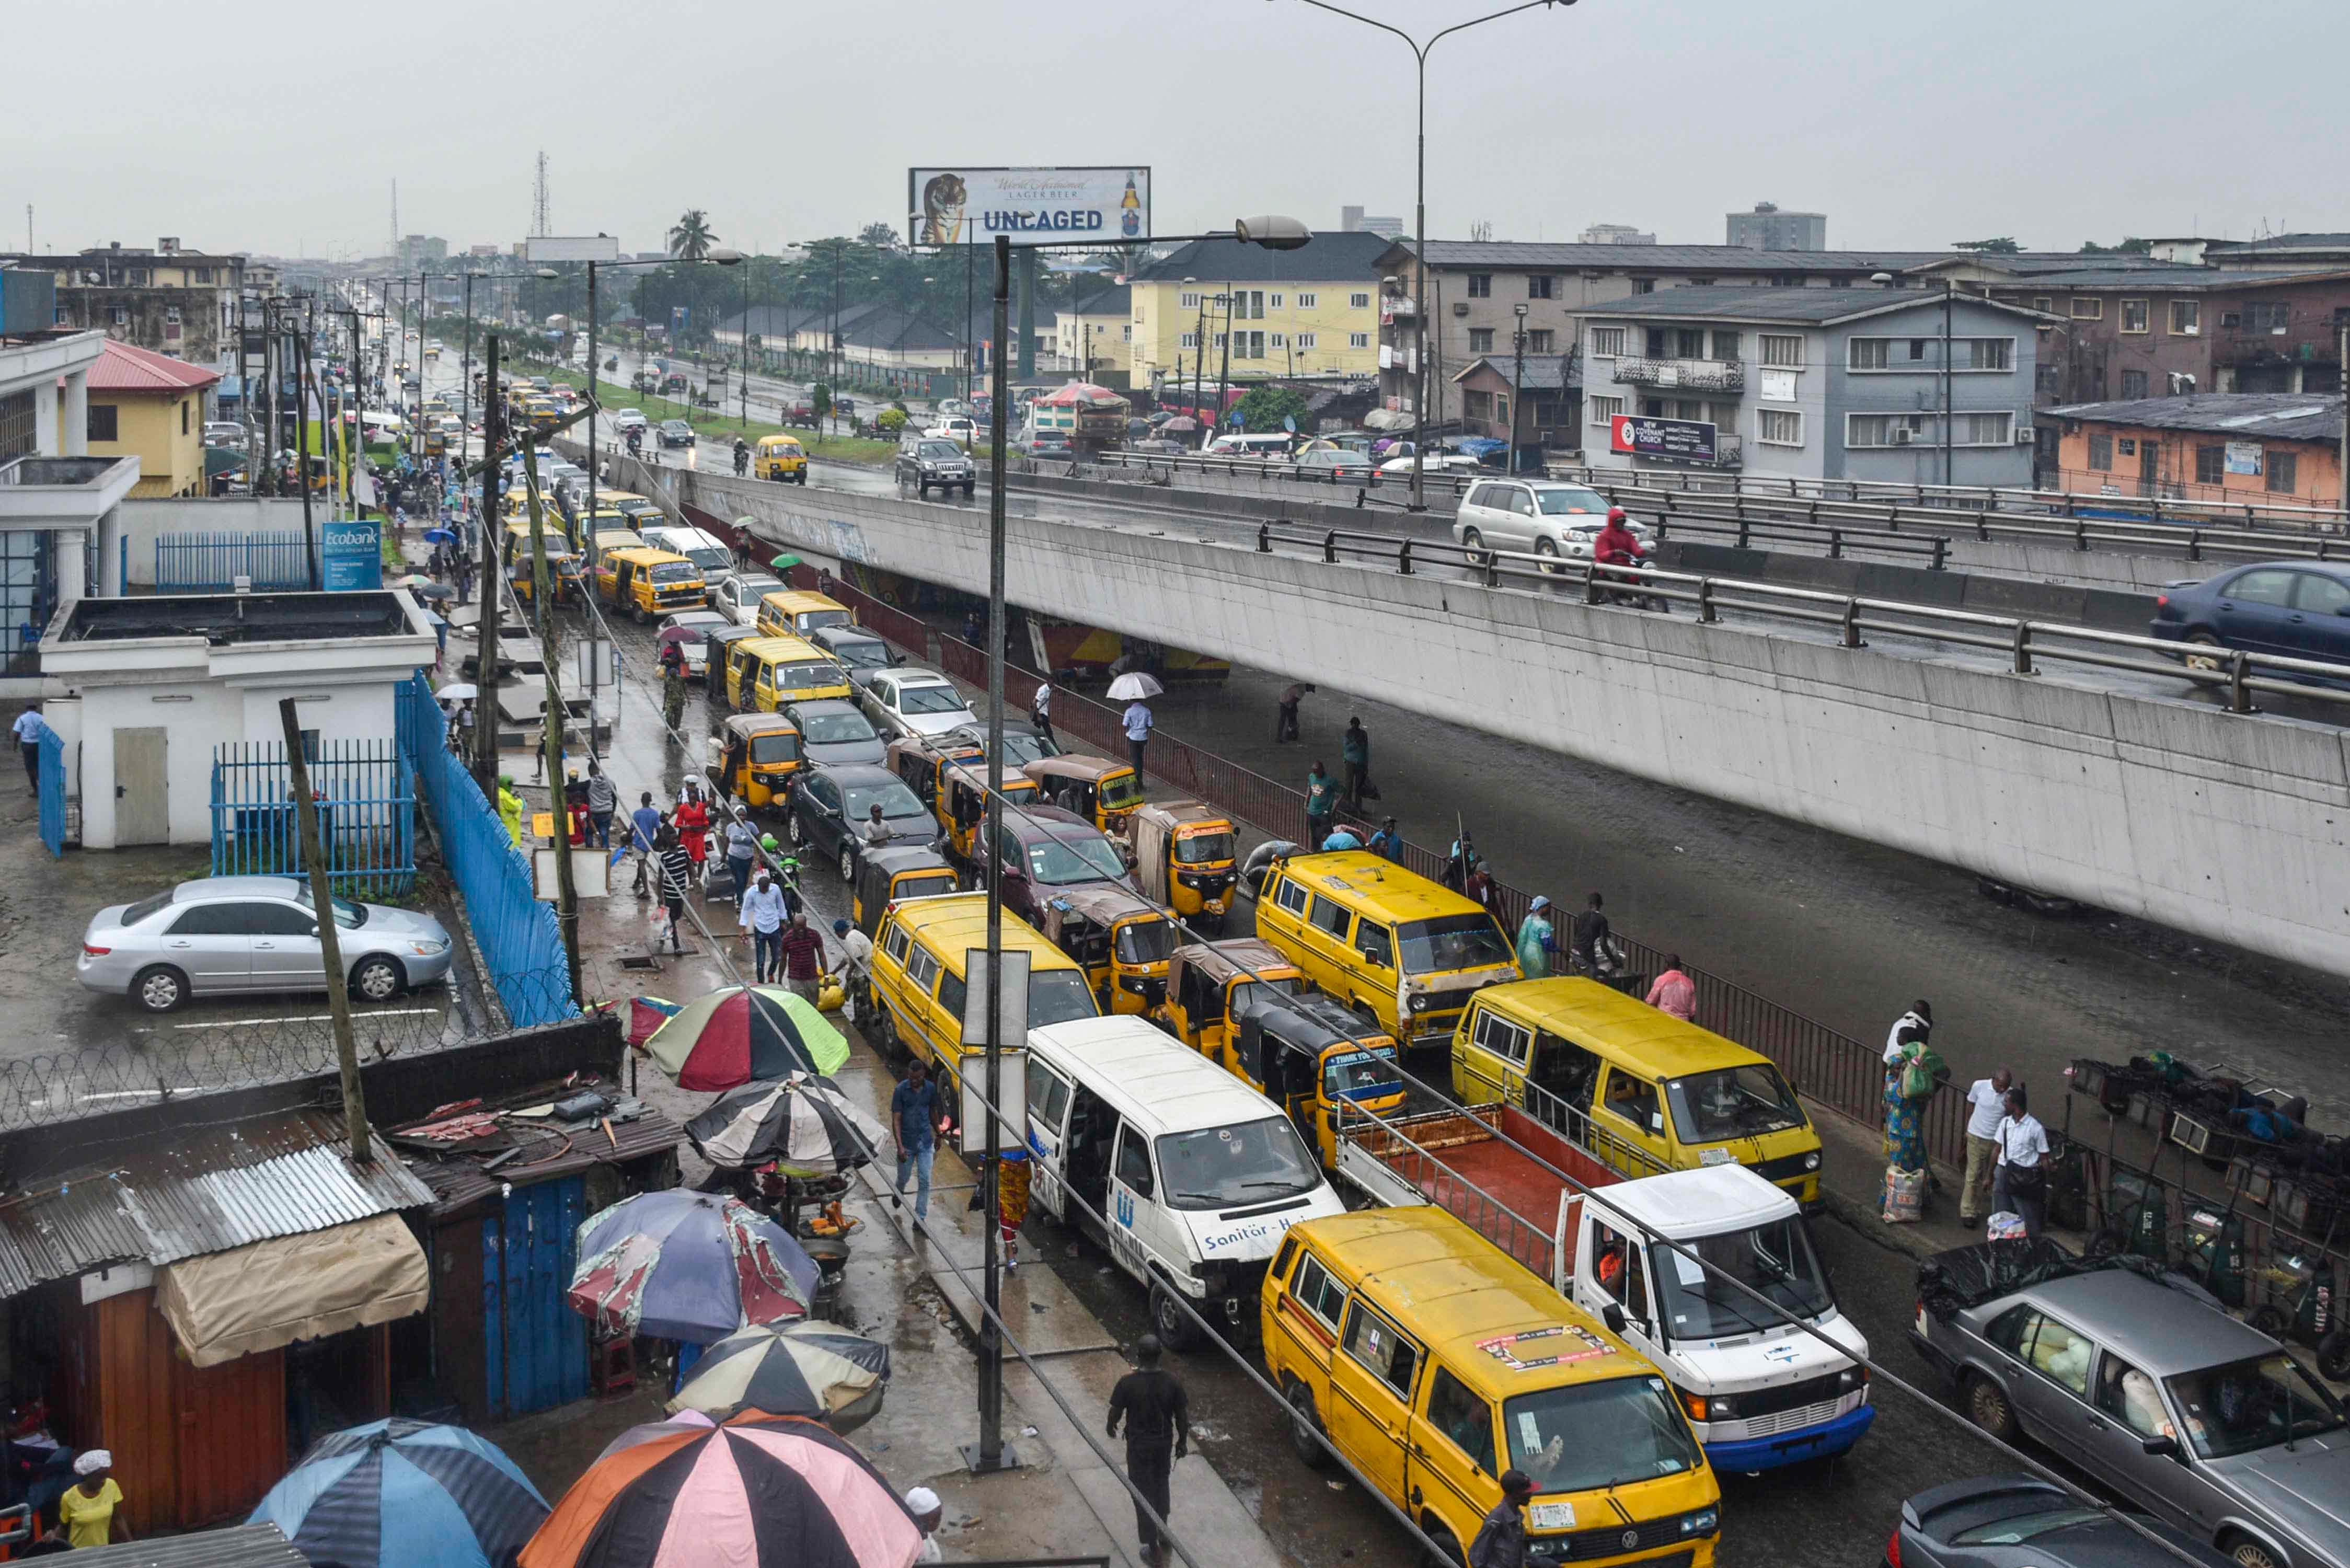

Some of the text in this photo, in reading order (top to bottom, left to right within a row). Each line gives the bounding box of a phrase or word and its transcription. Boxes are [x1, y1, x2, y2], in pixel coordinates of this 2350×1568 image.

[984, 210, 1103, 231] UNCAGED
[1643, 420, 1656, 429] NEW
[1635, 427, 1665, 437] COVENANT
[1639, 435, 1662, 444] CHURCH
[326, 527, 377, 545] Ecobank
[1336, 1052, 1358, 1065] THANK
[1204, 1224, 1268, 1250] Sanitär
